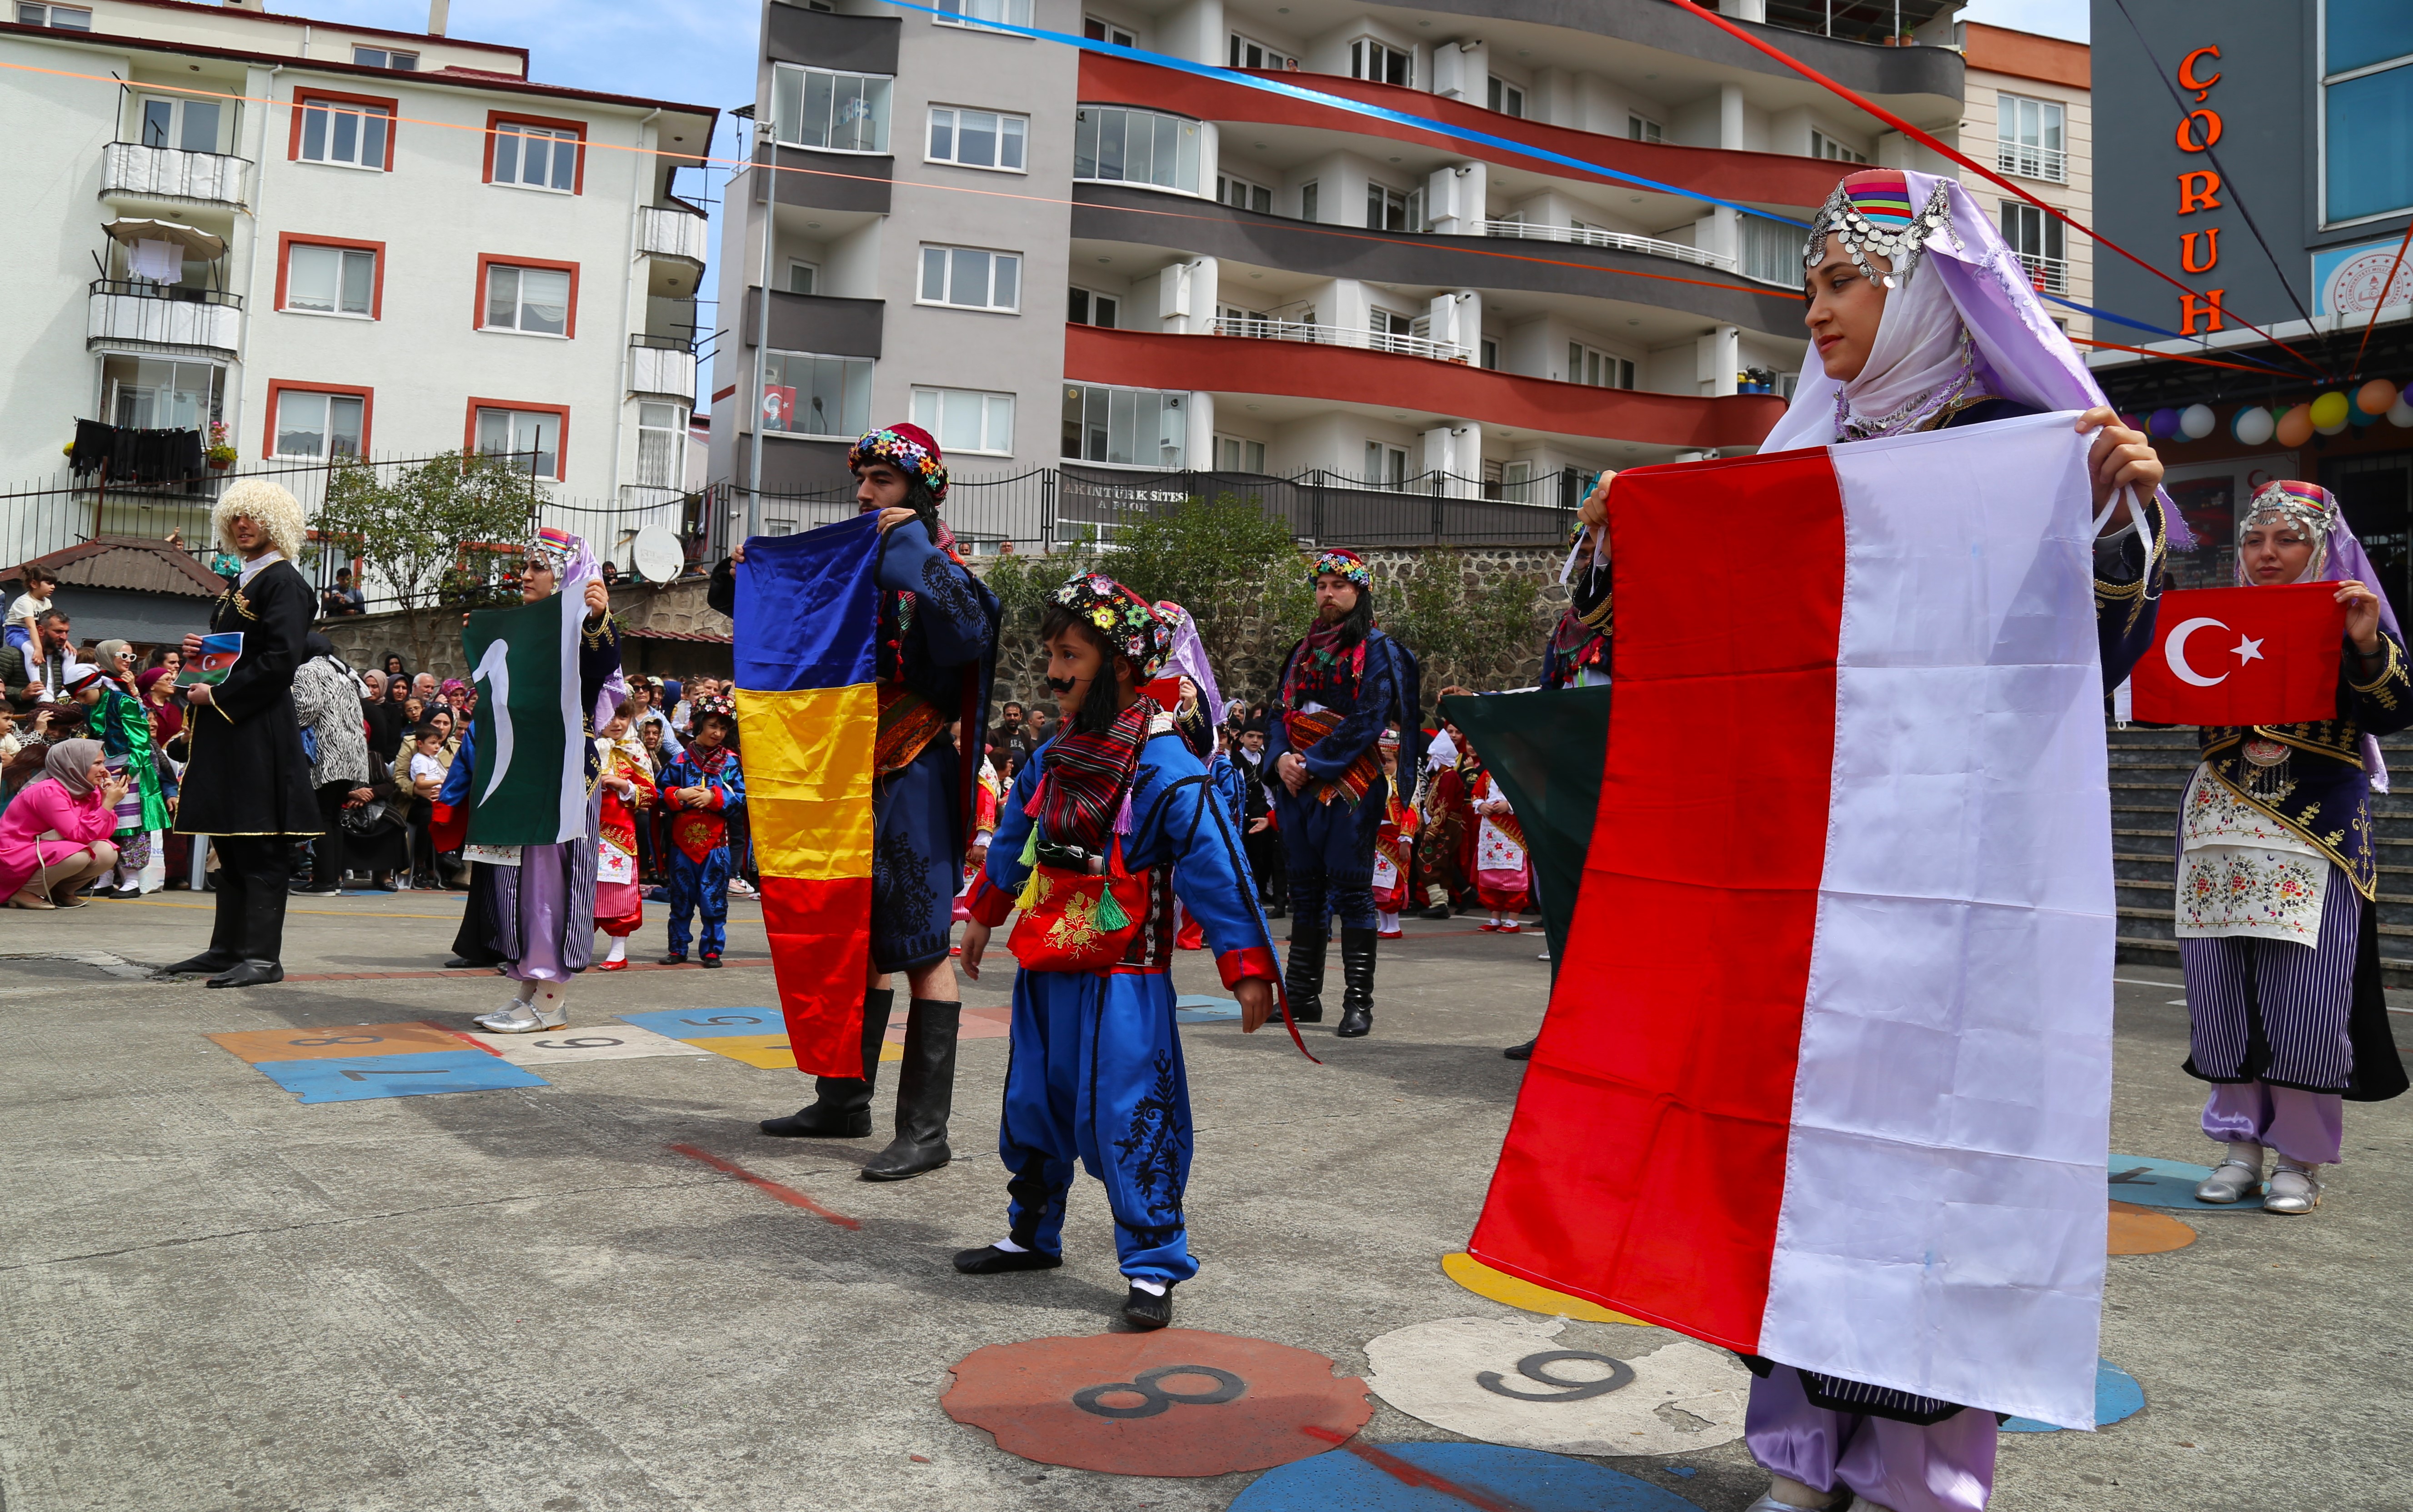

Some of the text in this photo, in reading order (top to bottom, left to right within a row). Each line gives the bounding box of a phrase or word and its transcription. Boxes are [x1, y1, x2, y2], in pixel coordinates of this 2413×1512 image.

[2176, 44, 2224, 335] ÇORUH
[1063, 483, 1189, 503] AKINTÜRK SİTESİ
[1097, 500, 1149, 512] A BLOK
[679, 1016, 763, 1026] 5
[288, 1035, 385, 1046] 8
[338, 1070, 451, 1082] 7
[1073, 1364, 1247, 1418] 8
